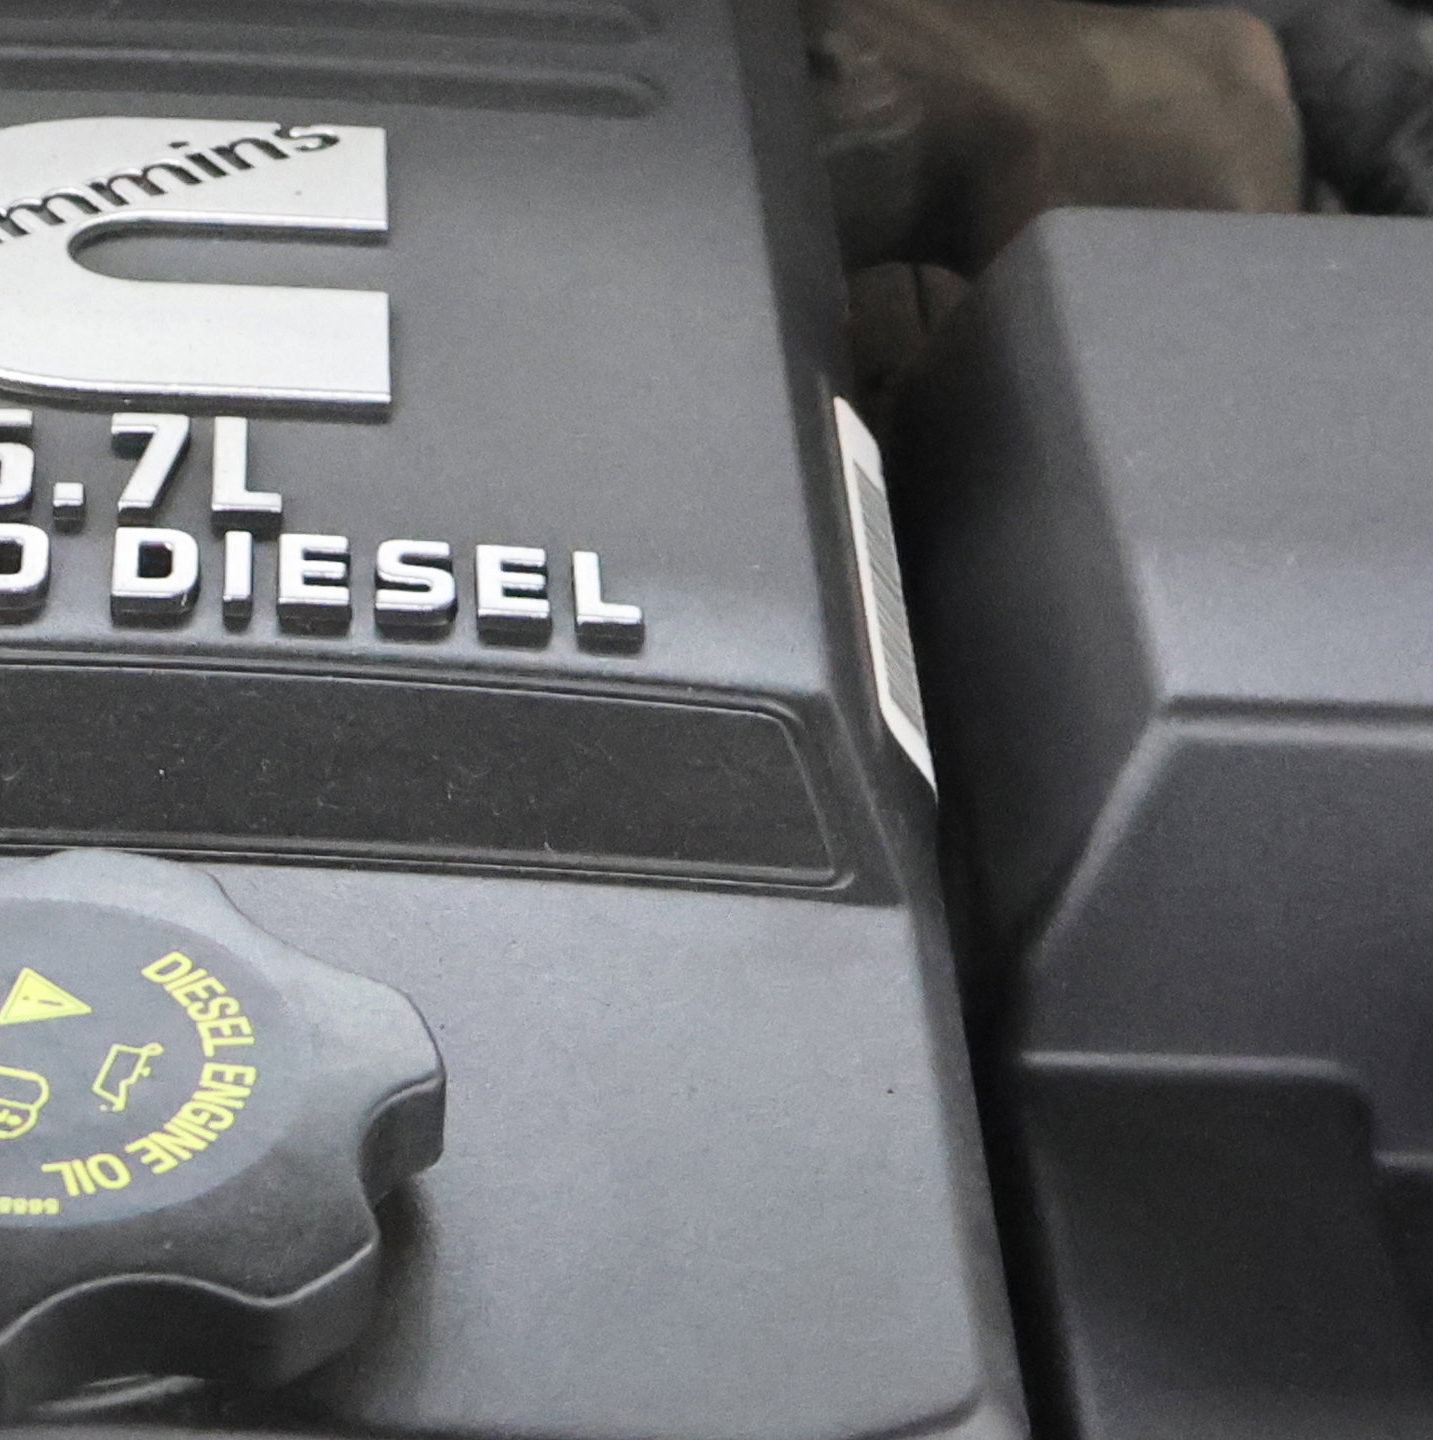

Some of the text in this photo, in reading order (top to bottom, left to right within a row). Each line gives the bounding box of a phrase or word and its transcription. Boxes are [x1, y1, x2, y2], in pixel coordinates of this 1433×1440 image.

[109, 526, 647, 654] DIESEL
[40, 951, 257, 1198] DIESEL ENGINE OIL
